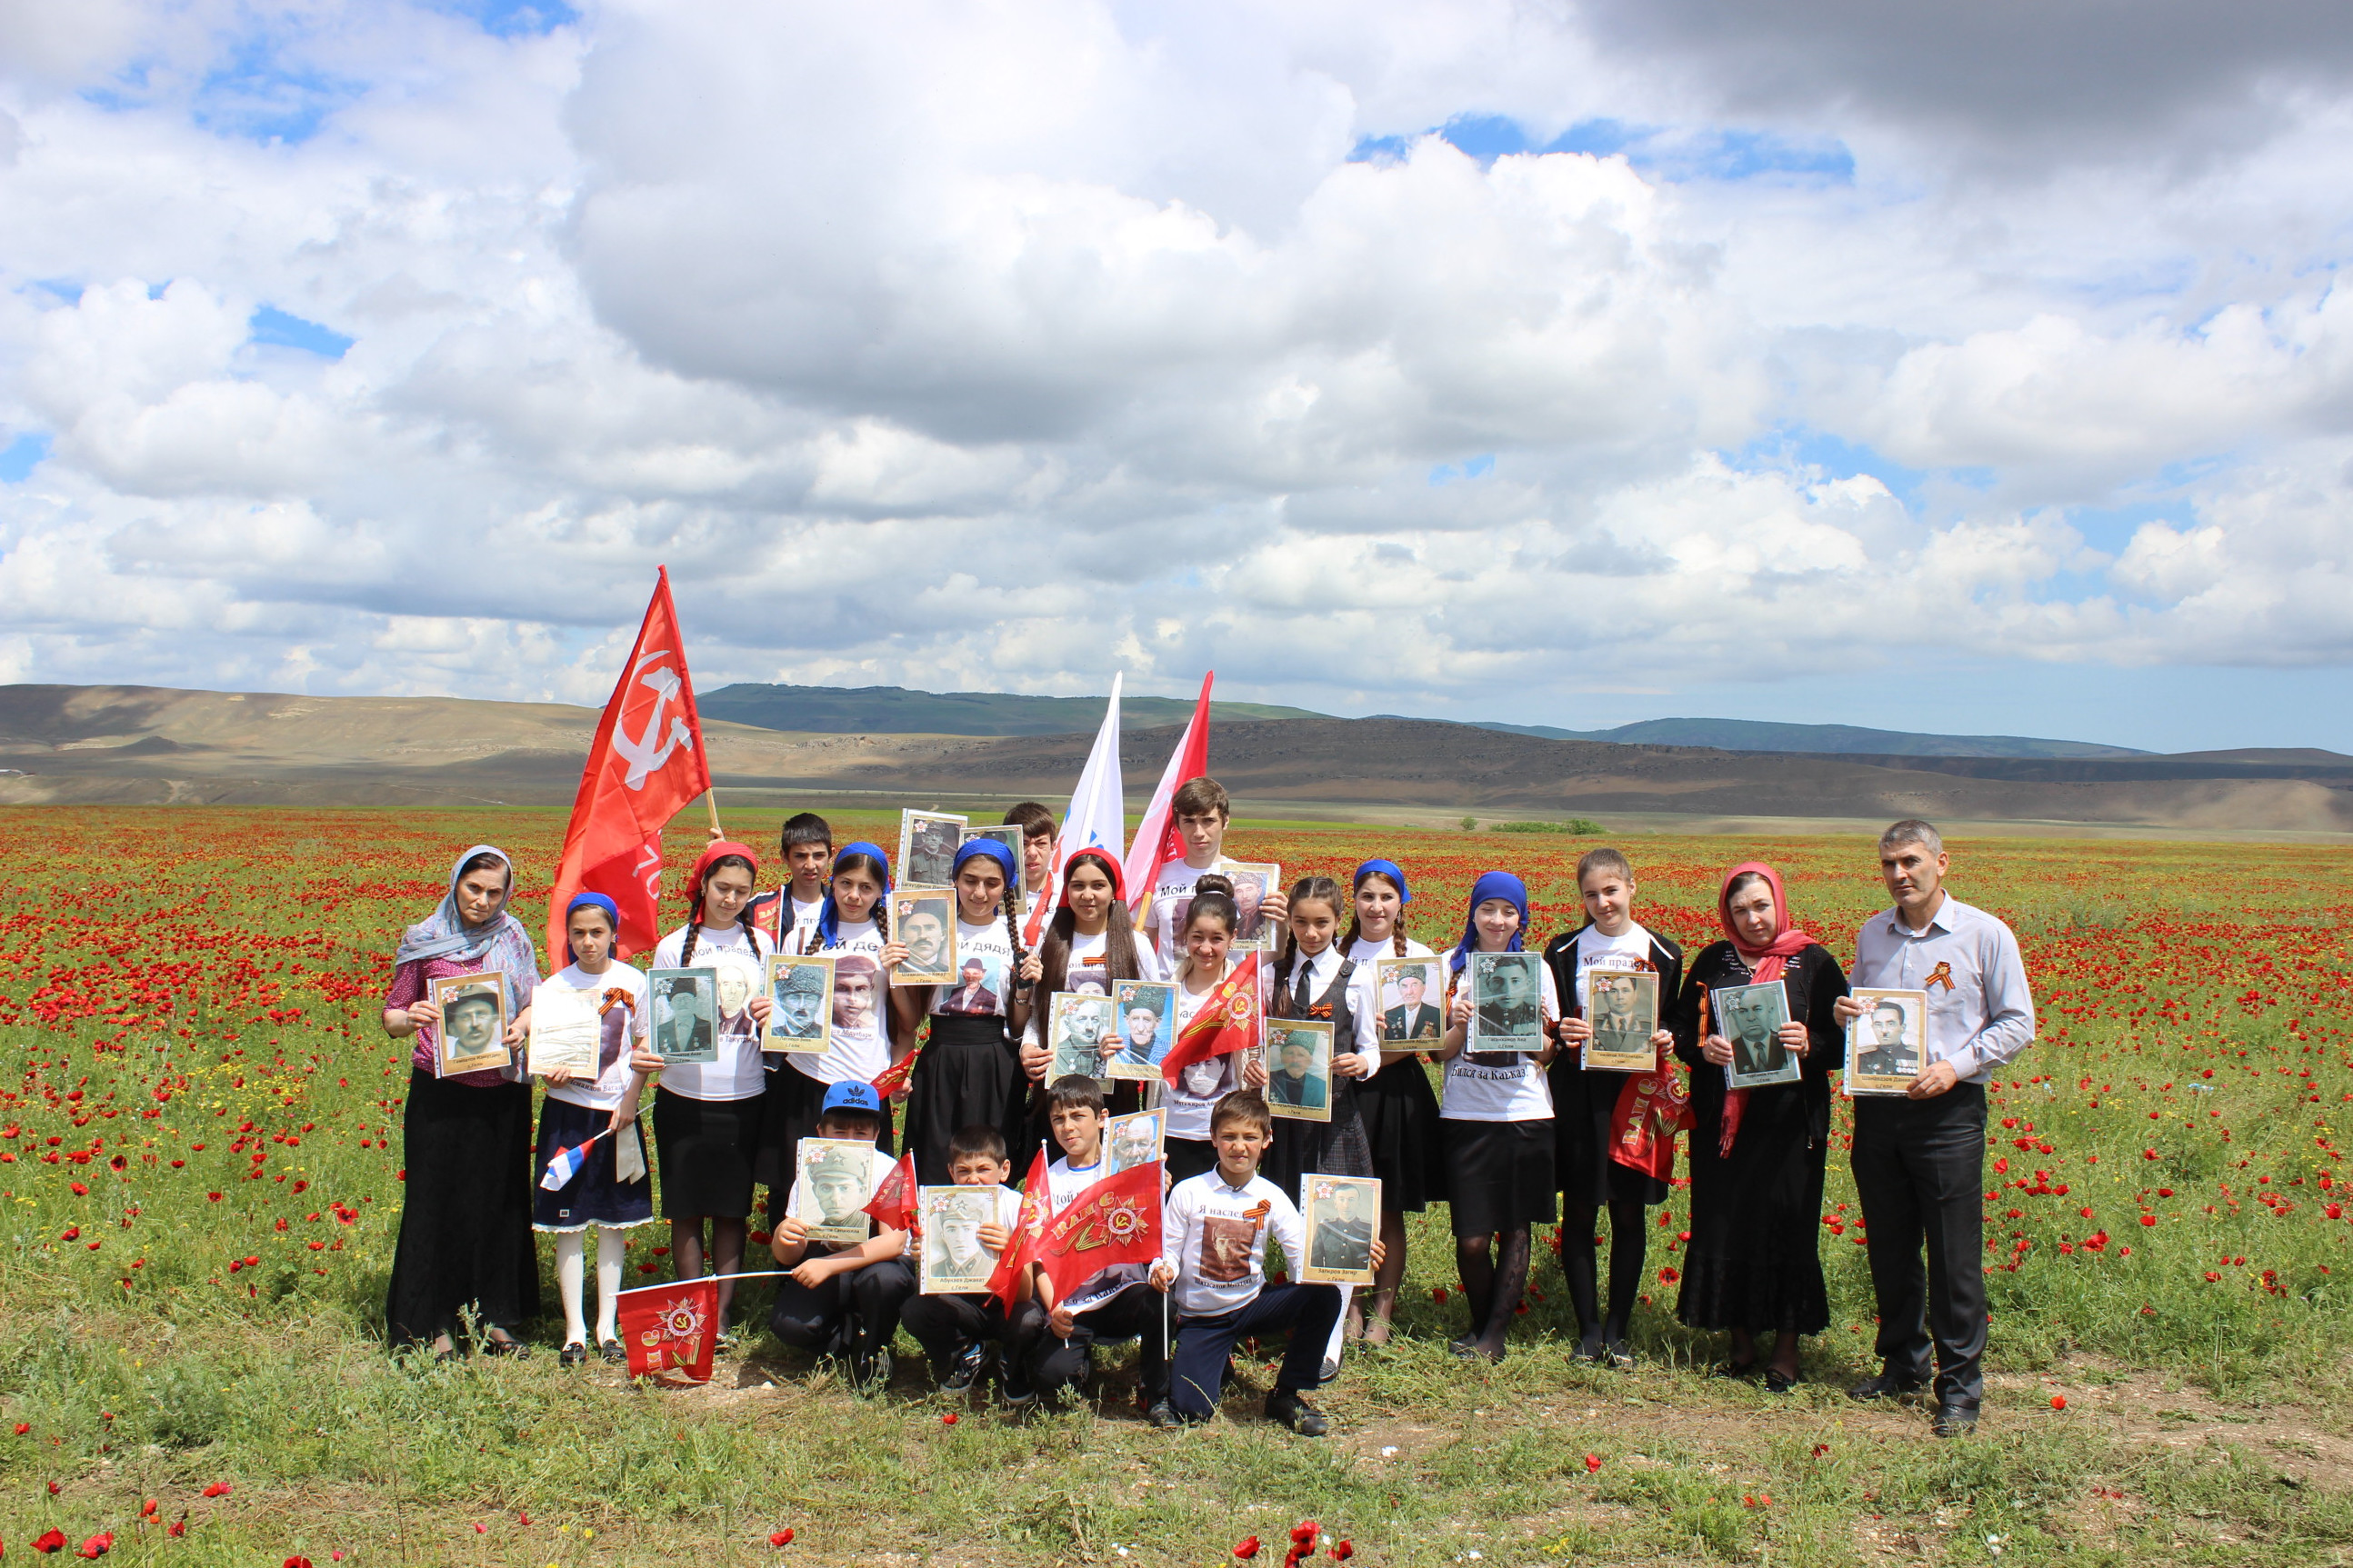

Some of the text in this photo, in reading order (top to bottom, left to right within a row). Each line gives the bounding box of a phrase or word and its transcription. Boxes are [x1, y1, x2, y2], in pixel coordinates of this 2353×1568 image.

[1160, 883, 1187, 897] Мой
[973, 942, 1011, 956] дядя
[1583, 956, 1640, 970] Мой праде
[1451, 1064, 1529, 1081] Бился за Кавказ!
[842, 1097, 869, 1106] adidas
[1198, 1204, 1207, 1213] Я
